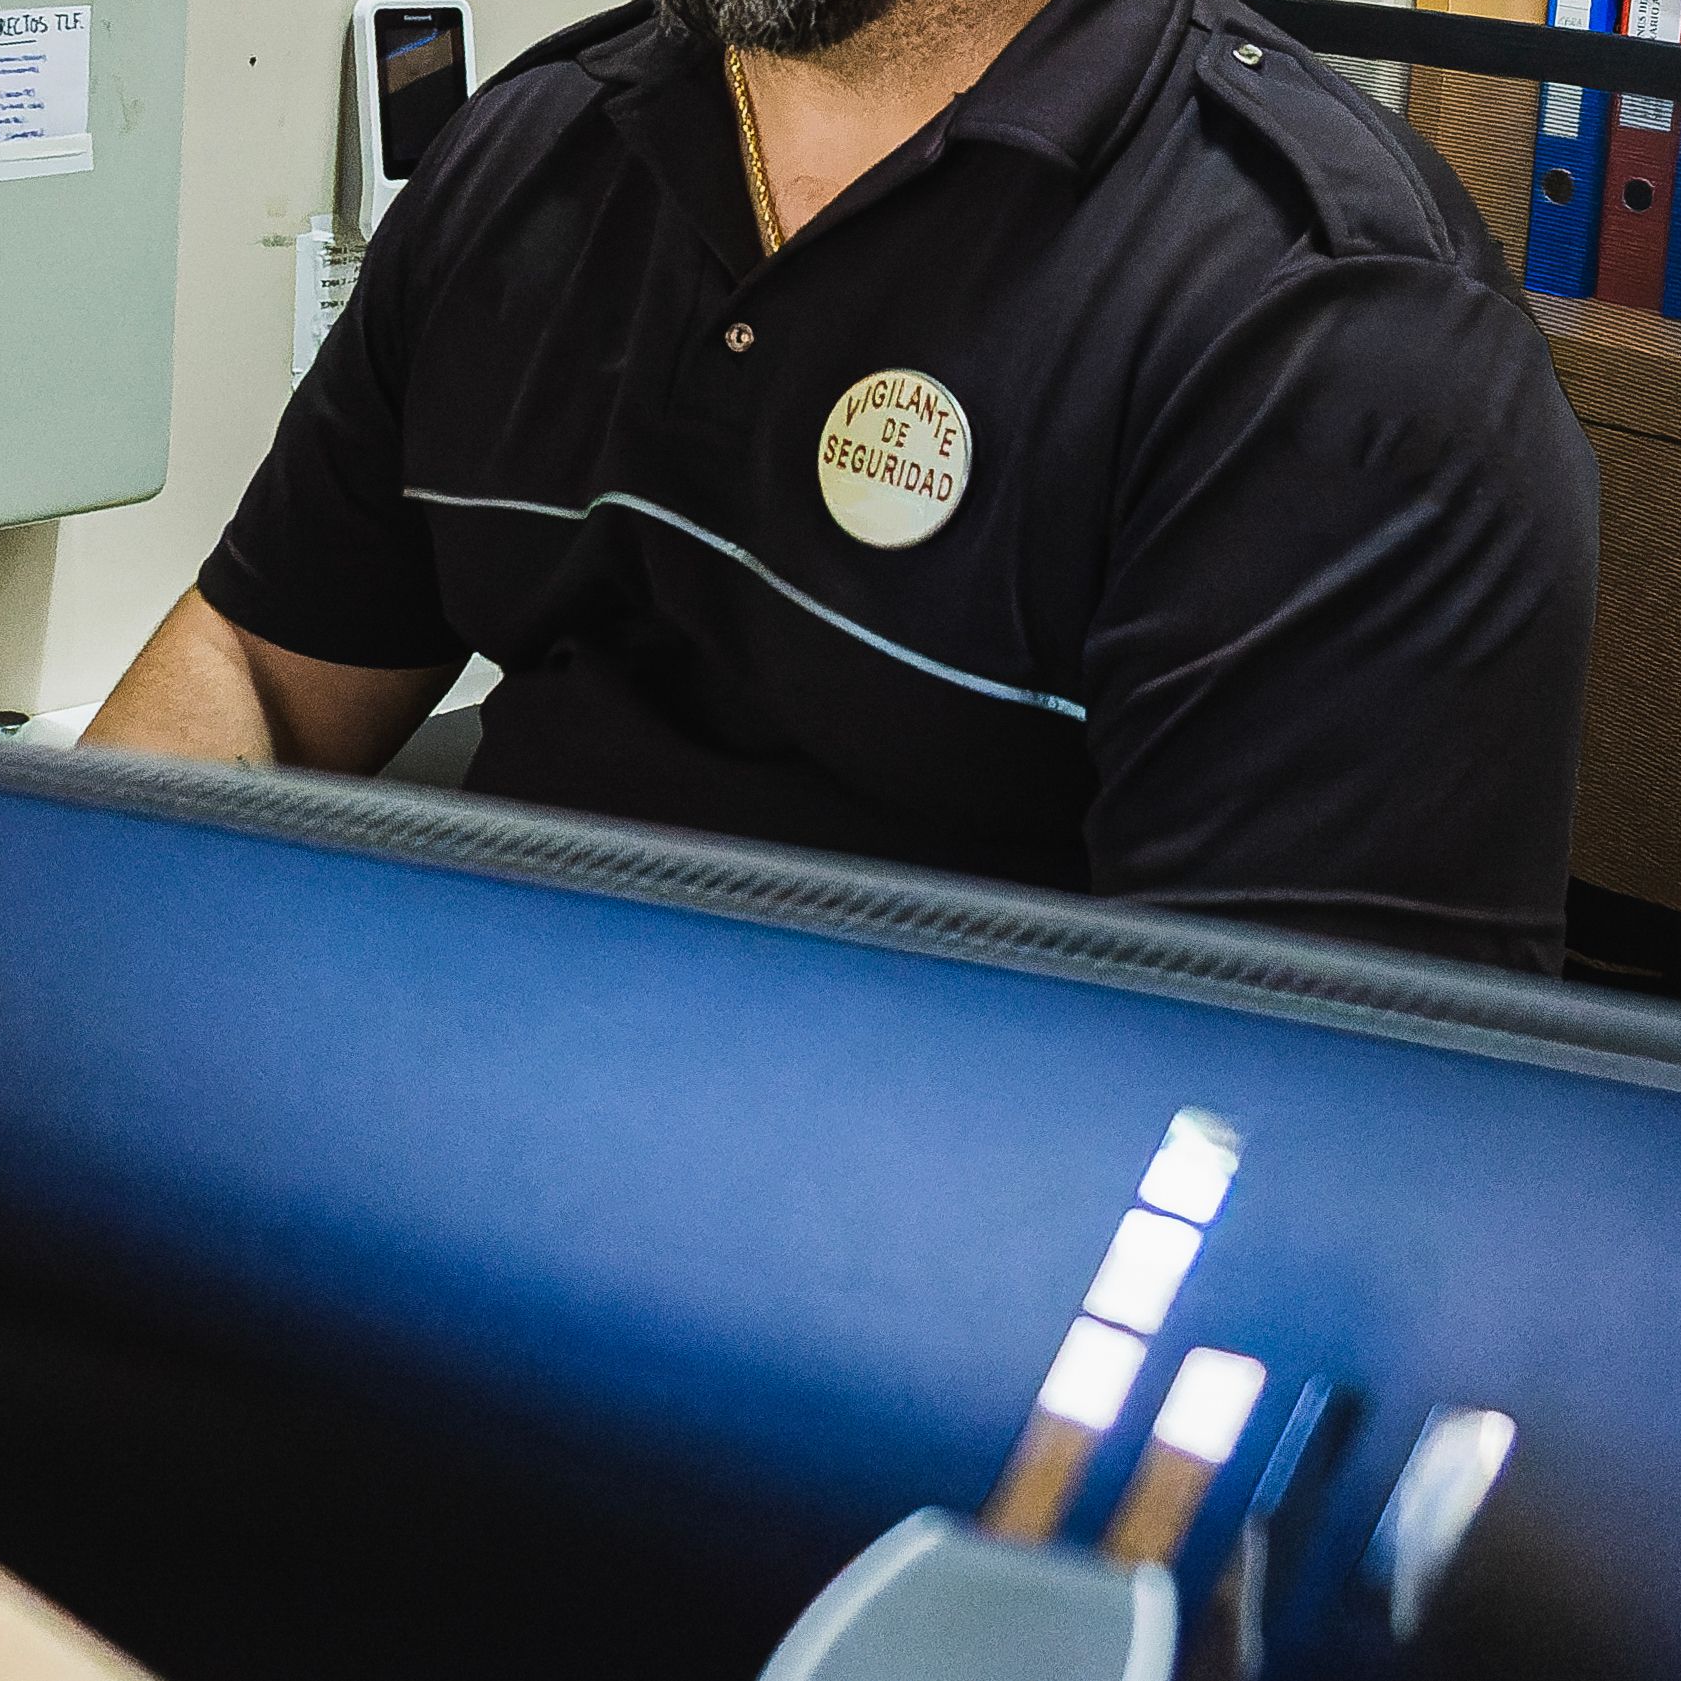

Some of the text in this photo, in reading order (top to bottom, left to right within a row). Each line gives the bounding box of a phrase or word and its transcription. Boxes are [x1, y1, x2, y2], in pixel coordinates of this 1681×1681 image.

[845, 377, 957, 460] VIGILANTE
[881, 417, 911, 449] DE
[823, 433, 954, 502] SEGURIDAD
